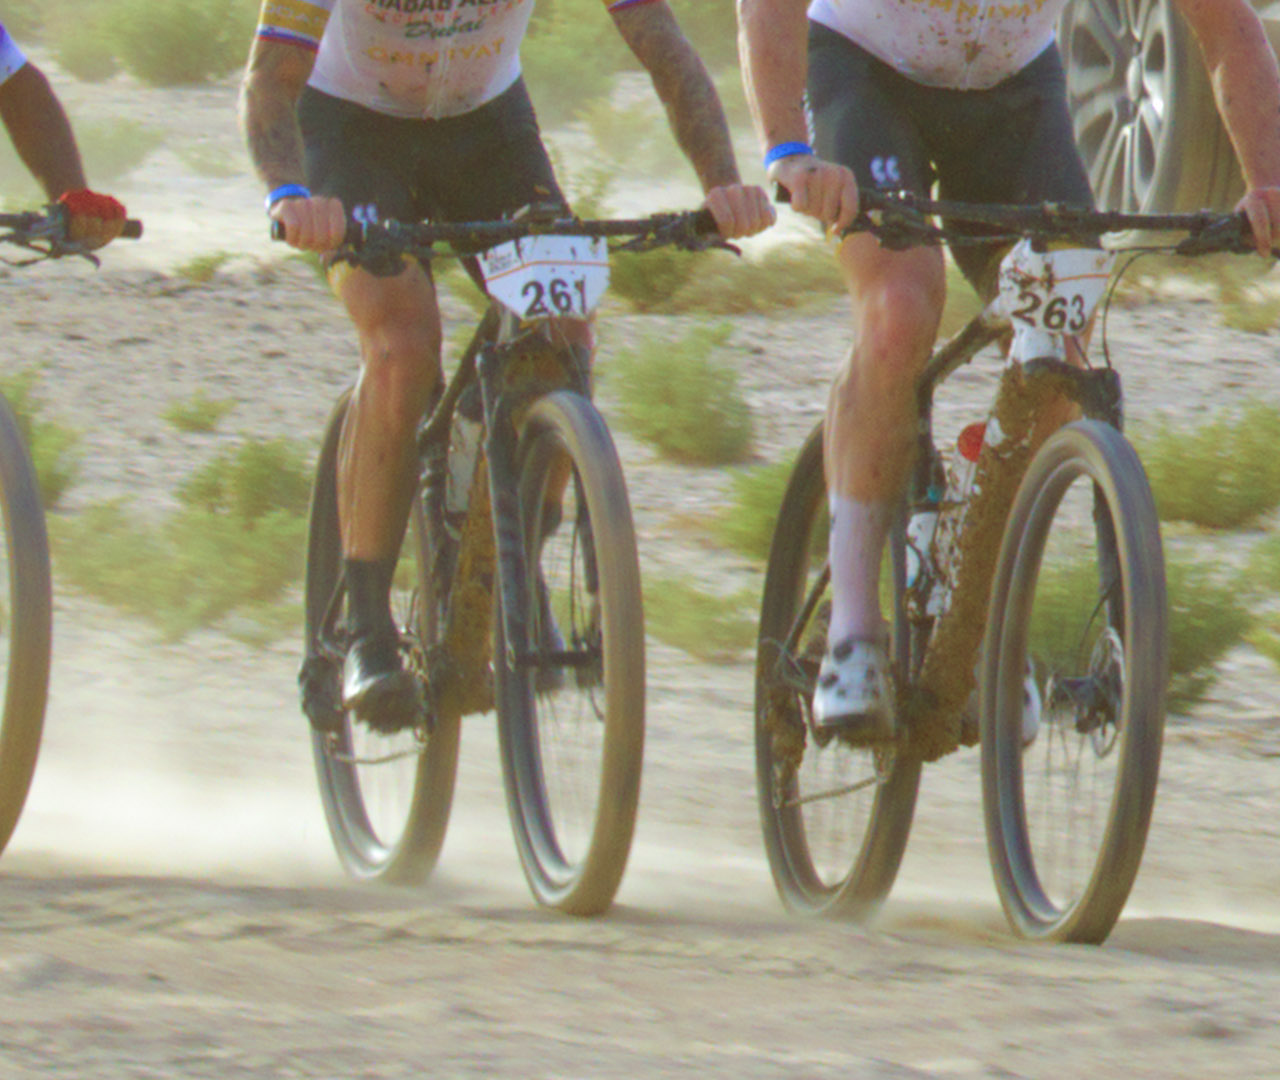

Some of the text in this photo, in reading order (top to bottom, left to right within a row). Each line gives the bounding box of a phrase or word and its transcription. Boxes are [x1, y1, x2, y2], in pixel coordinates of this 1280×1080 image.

[366, 37, 505, 64] OMNIYAT
[521, 277, 587, 317] 261
[1011, 291, 1086, 331] 263
